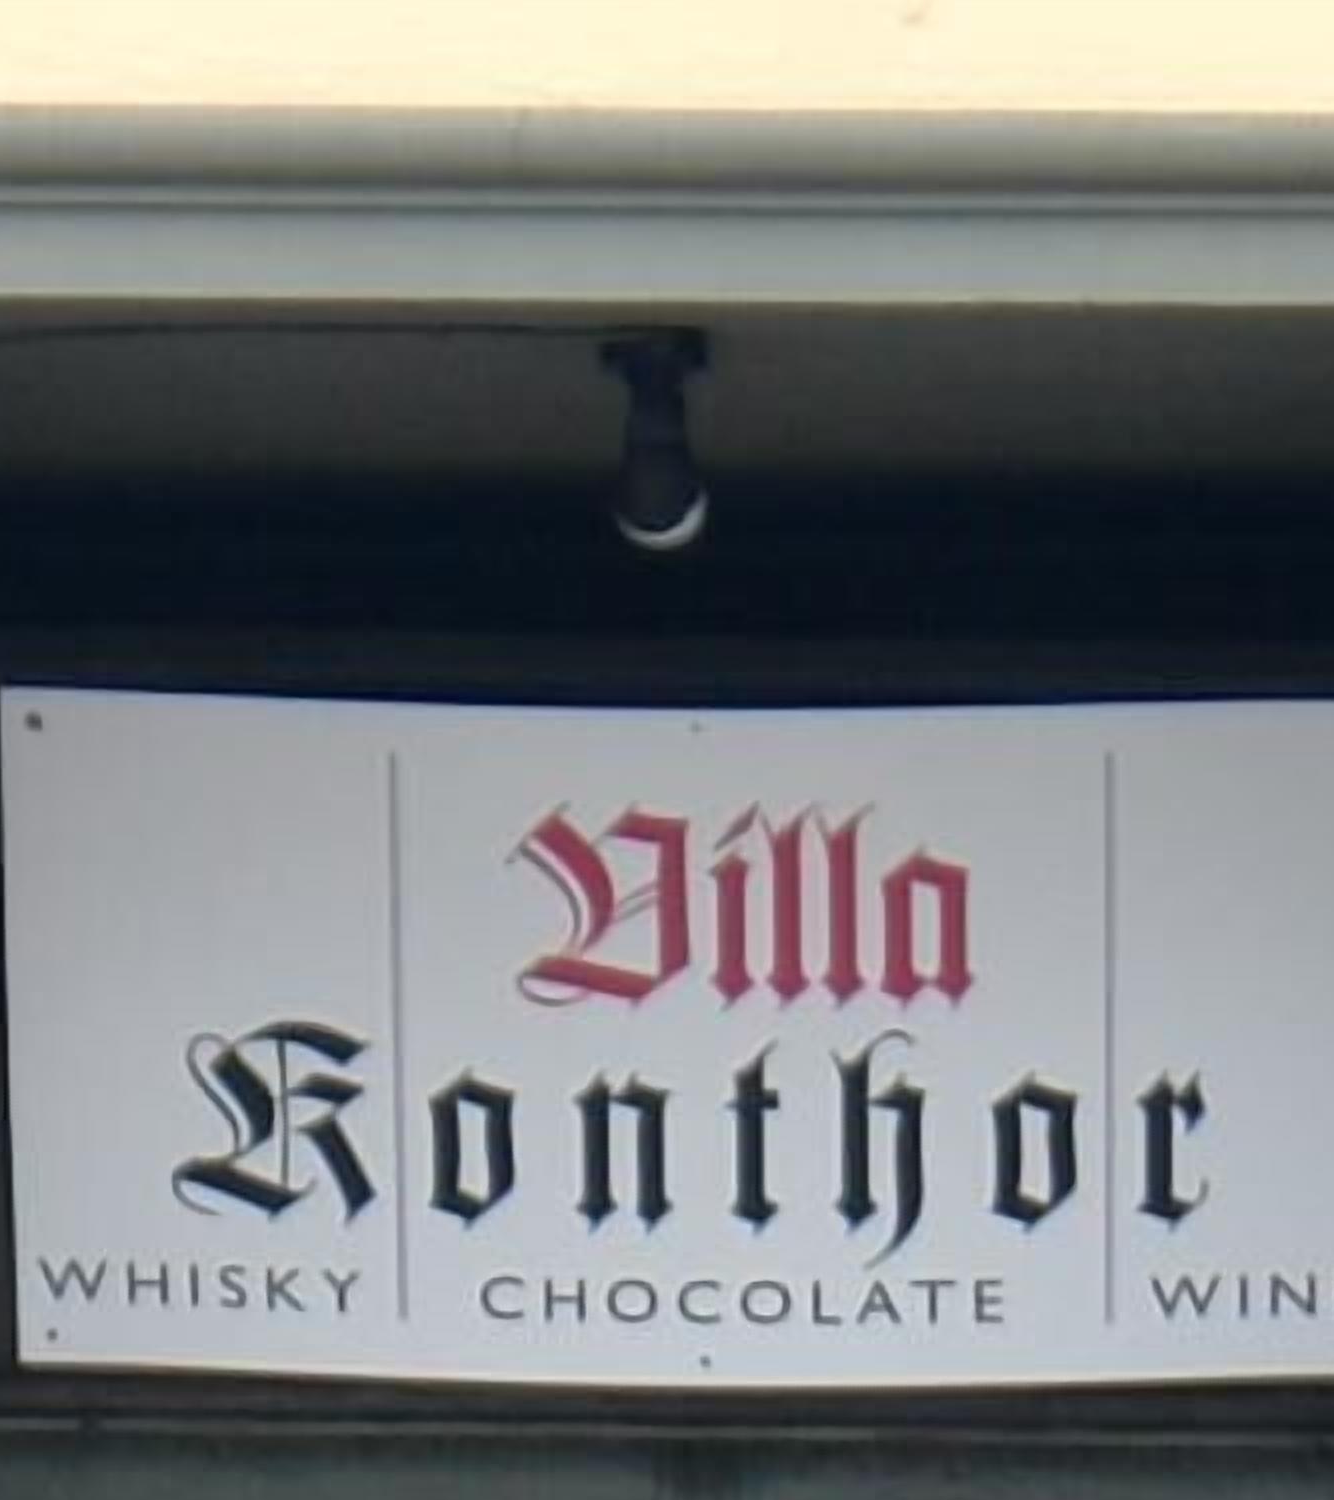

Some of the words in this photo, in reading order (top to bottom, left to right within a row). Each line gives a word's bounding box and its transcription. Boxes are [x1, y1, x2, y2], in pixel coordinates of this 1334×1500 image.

[505, 800, 975, 1008] Villa
[171, 1020, 1211, 1270] Konthor
[37, 1256, 361, 1314] WHISKY
[480, 1276, 1007, 1326] CHOCOLATE
